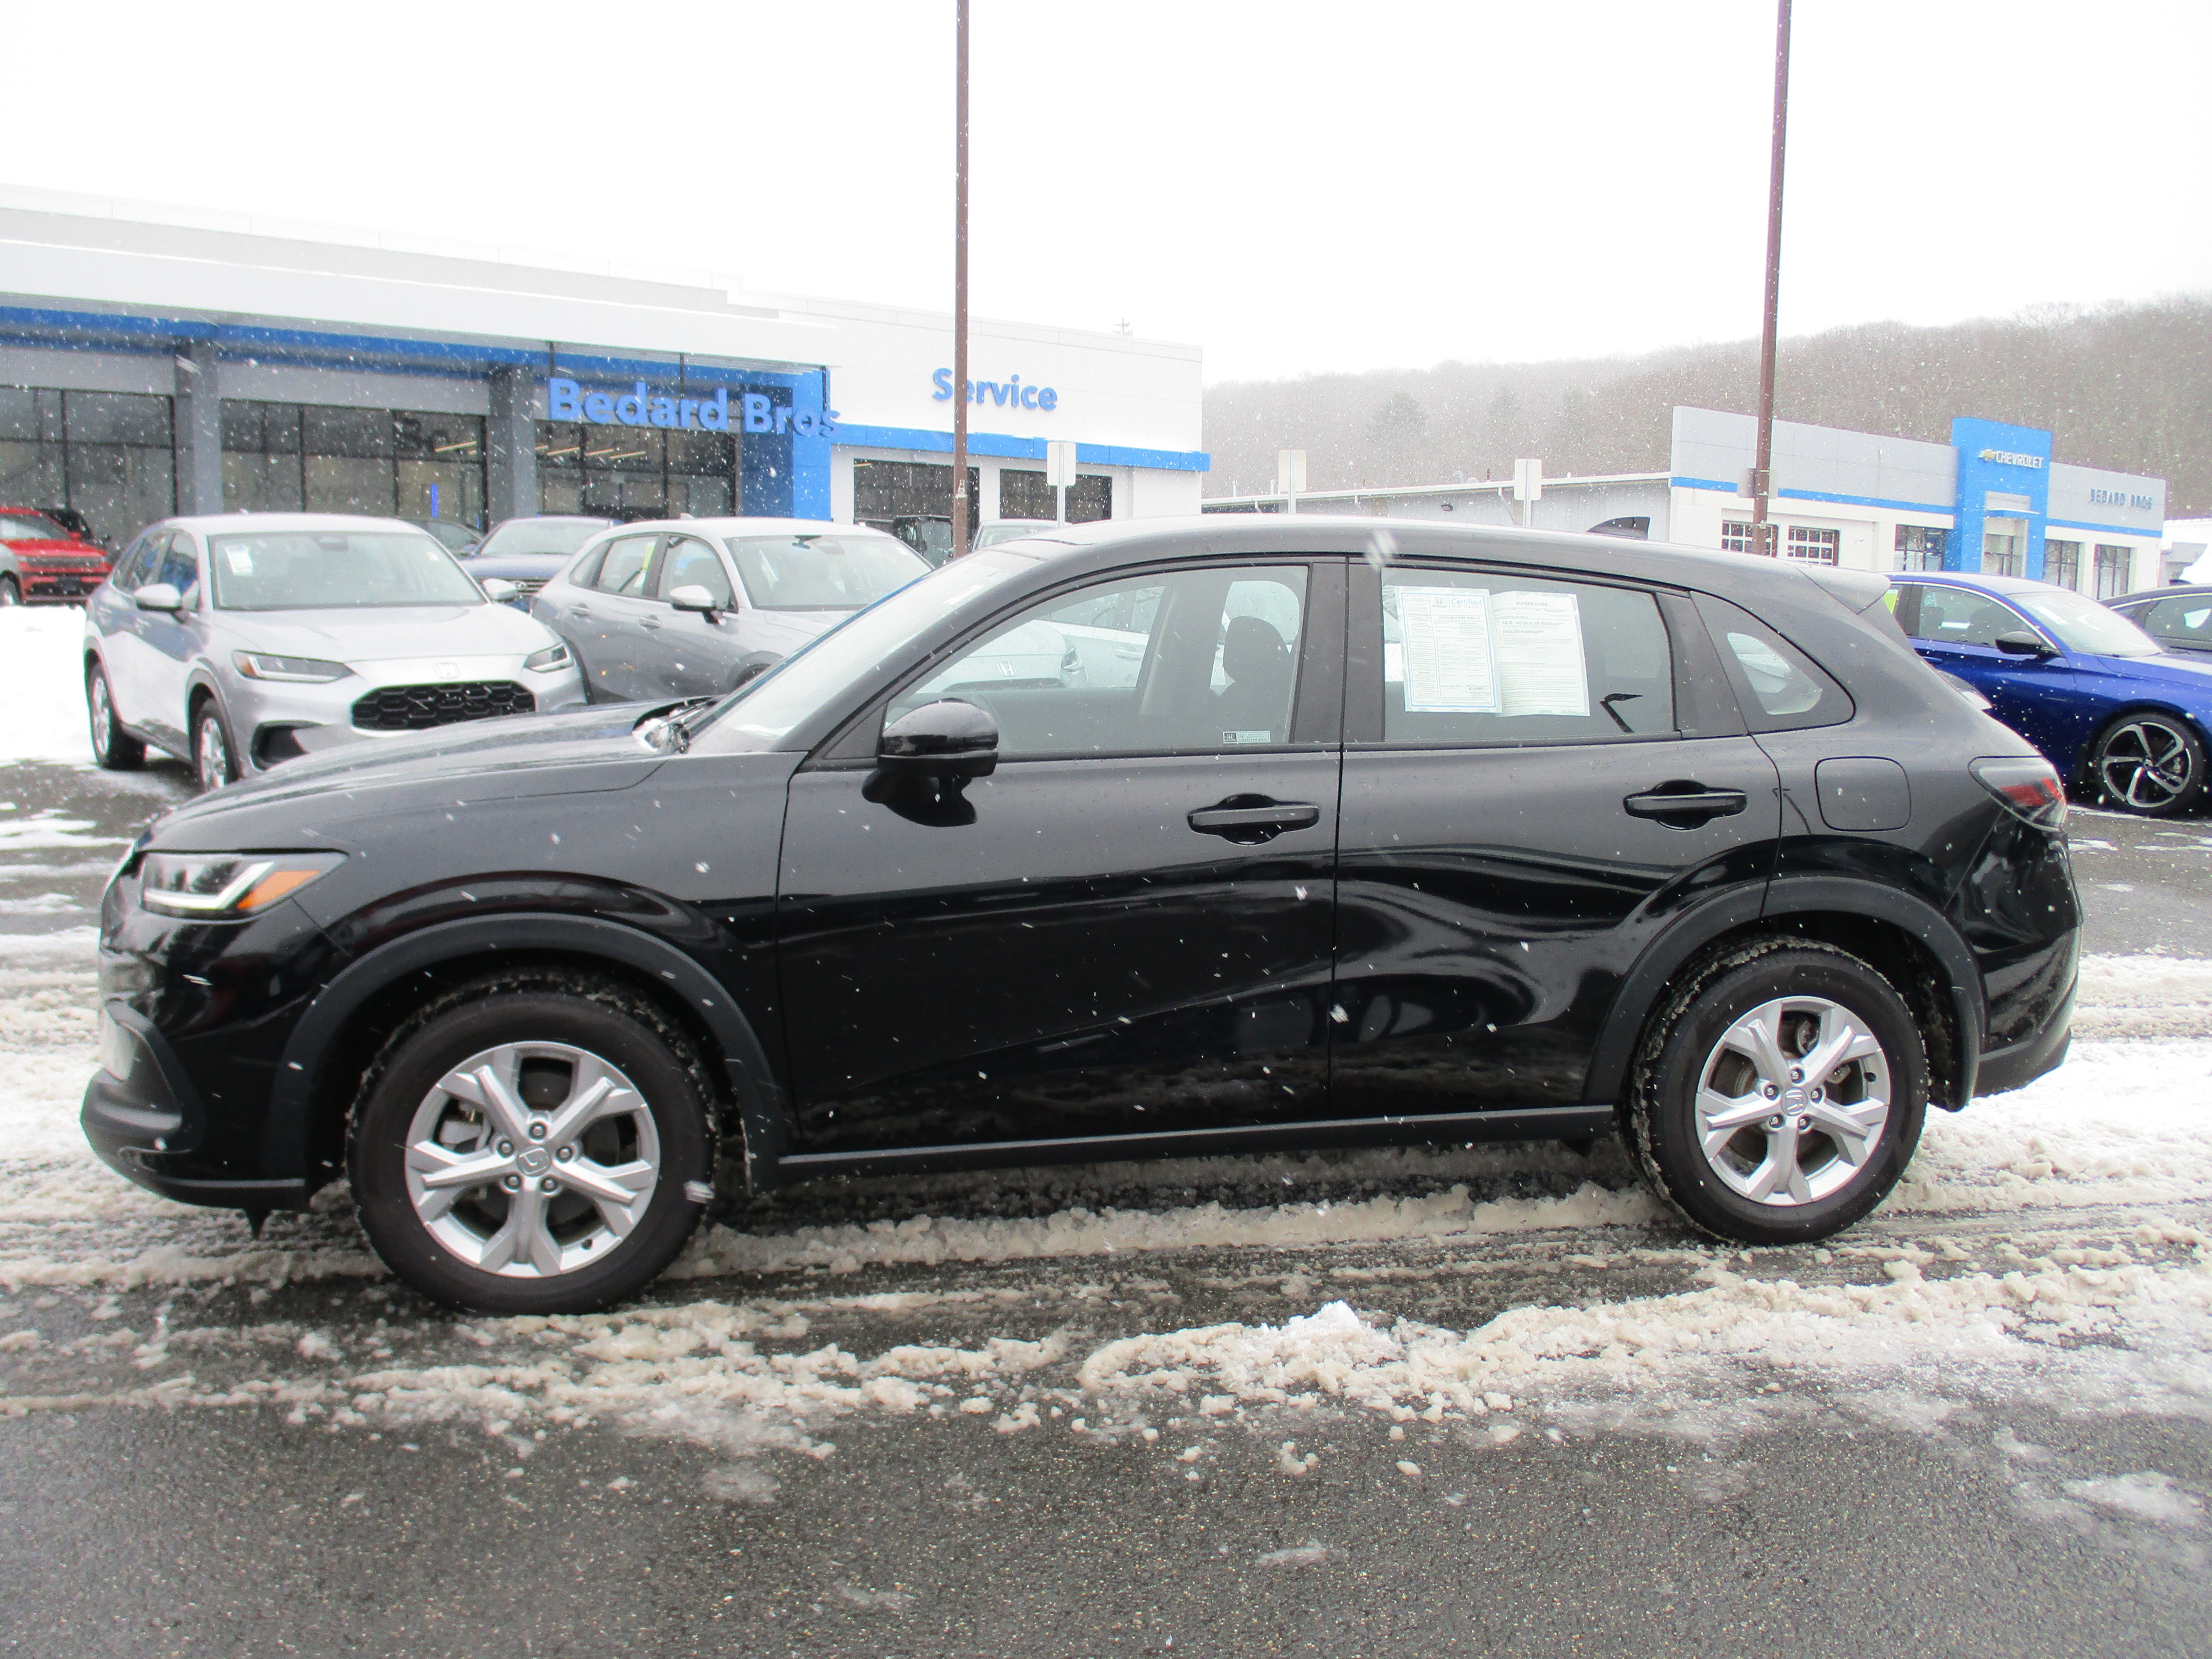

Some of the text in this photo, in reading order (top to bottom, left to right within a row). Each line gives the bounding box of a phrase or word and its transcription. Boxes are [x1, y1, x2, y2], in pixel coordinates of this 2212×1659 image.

[548, 377, 842, 438] Bedard Bros
[1996, 450, 2044, 469] CHEVROLET
[2090, 488, 2154, 510] BEDARD BROS
